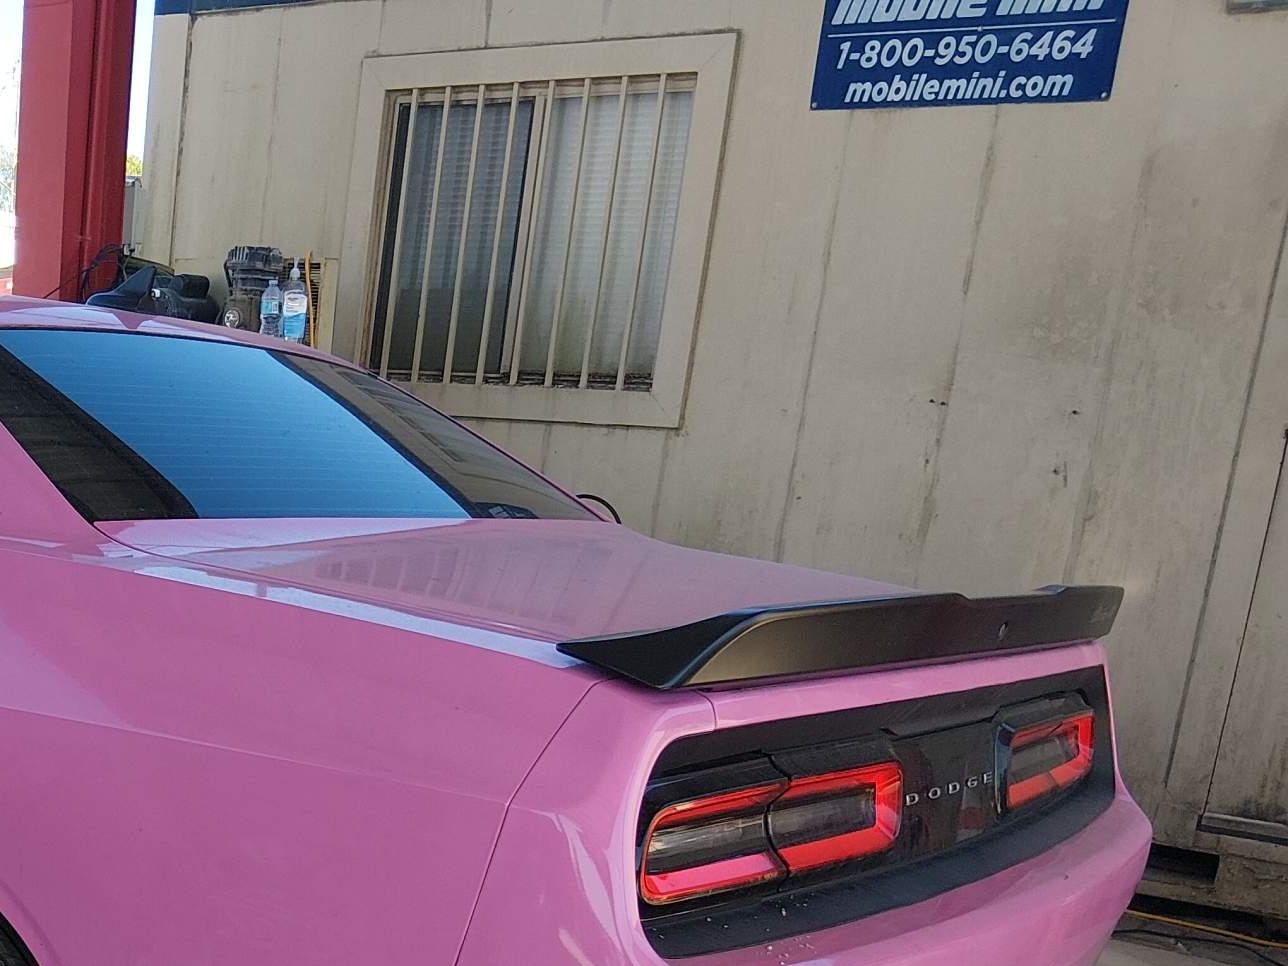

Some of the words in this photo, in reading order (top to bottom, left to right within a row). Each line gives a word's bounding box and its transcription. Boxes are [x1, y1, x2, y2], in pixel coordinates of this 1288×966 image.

[837, 28, 1098, 70] 1-800-950-6464
[844, 71, 1074, 103] mobilemini.com
[905, 771, 993, 806] DODGE
